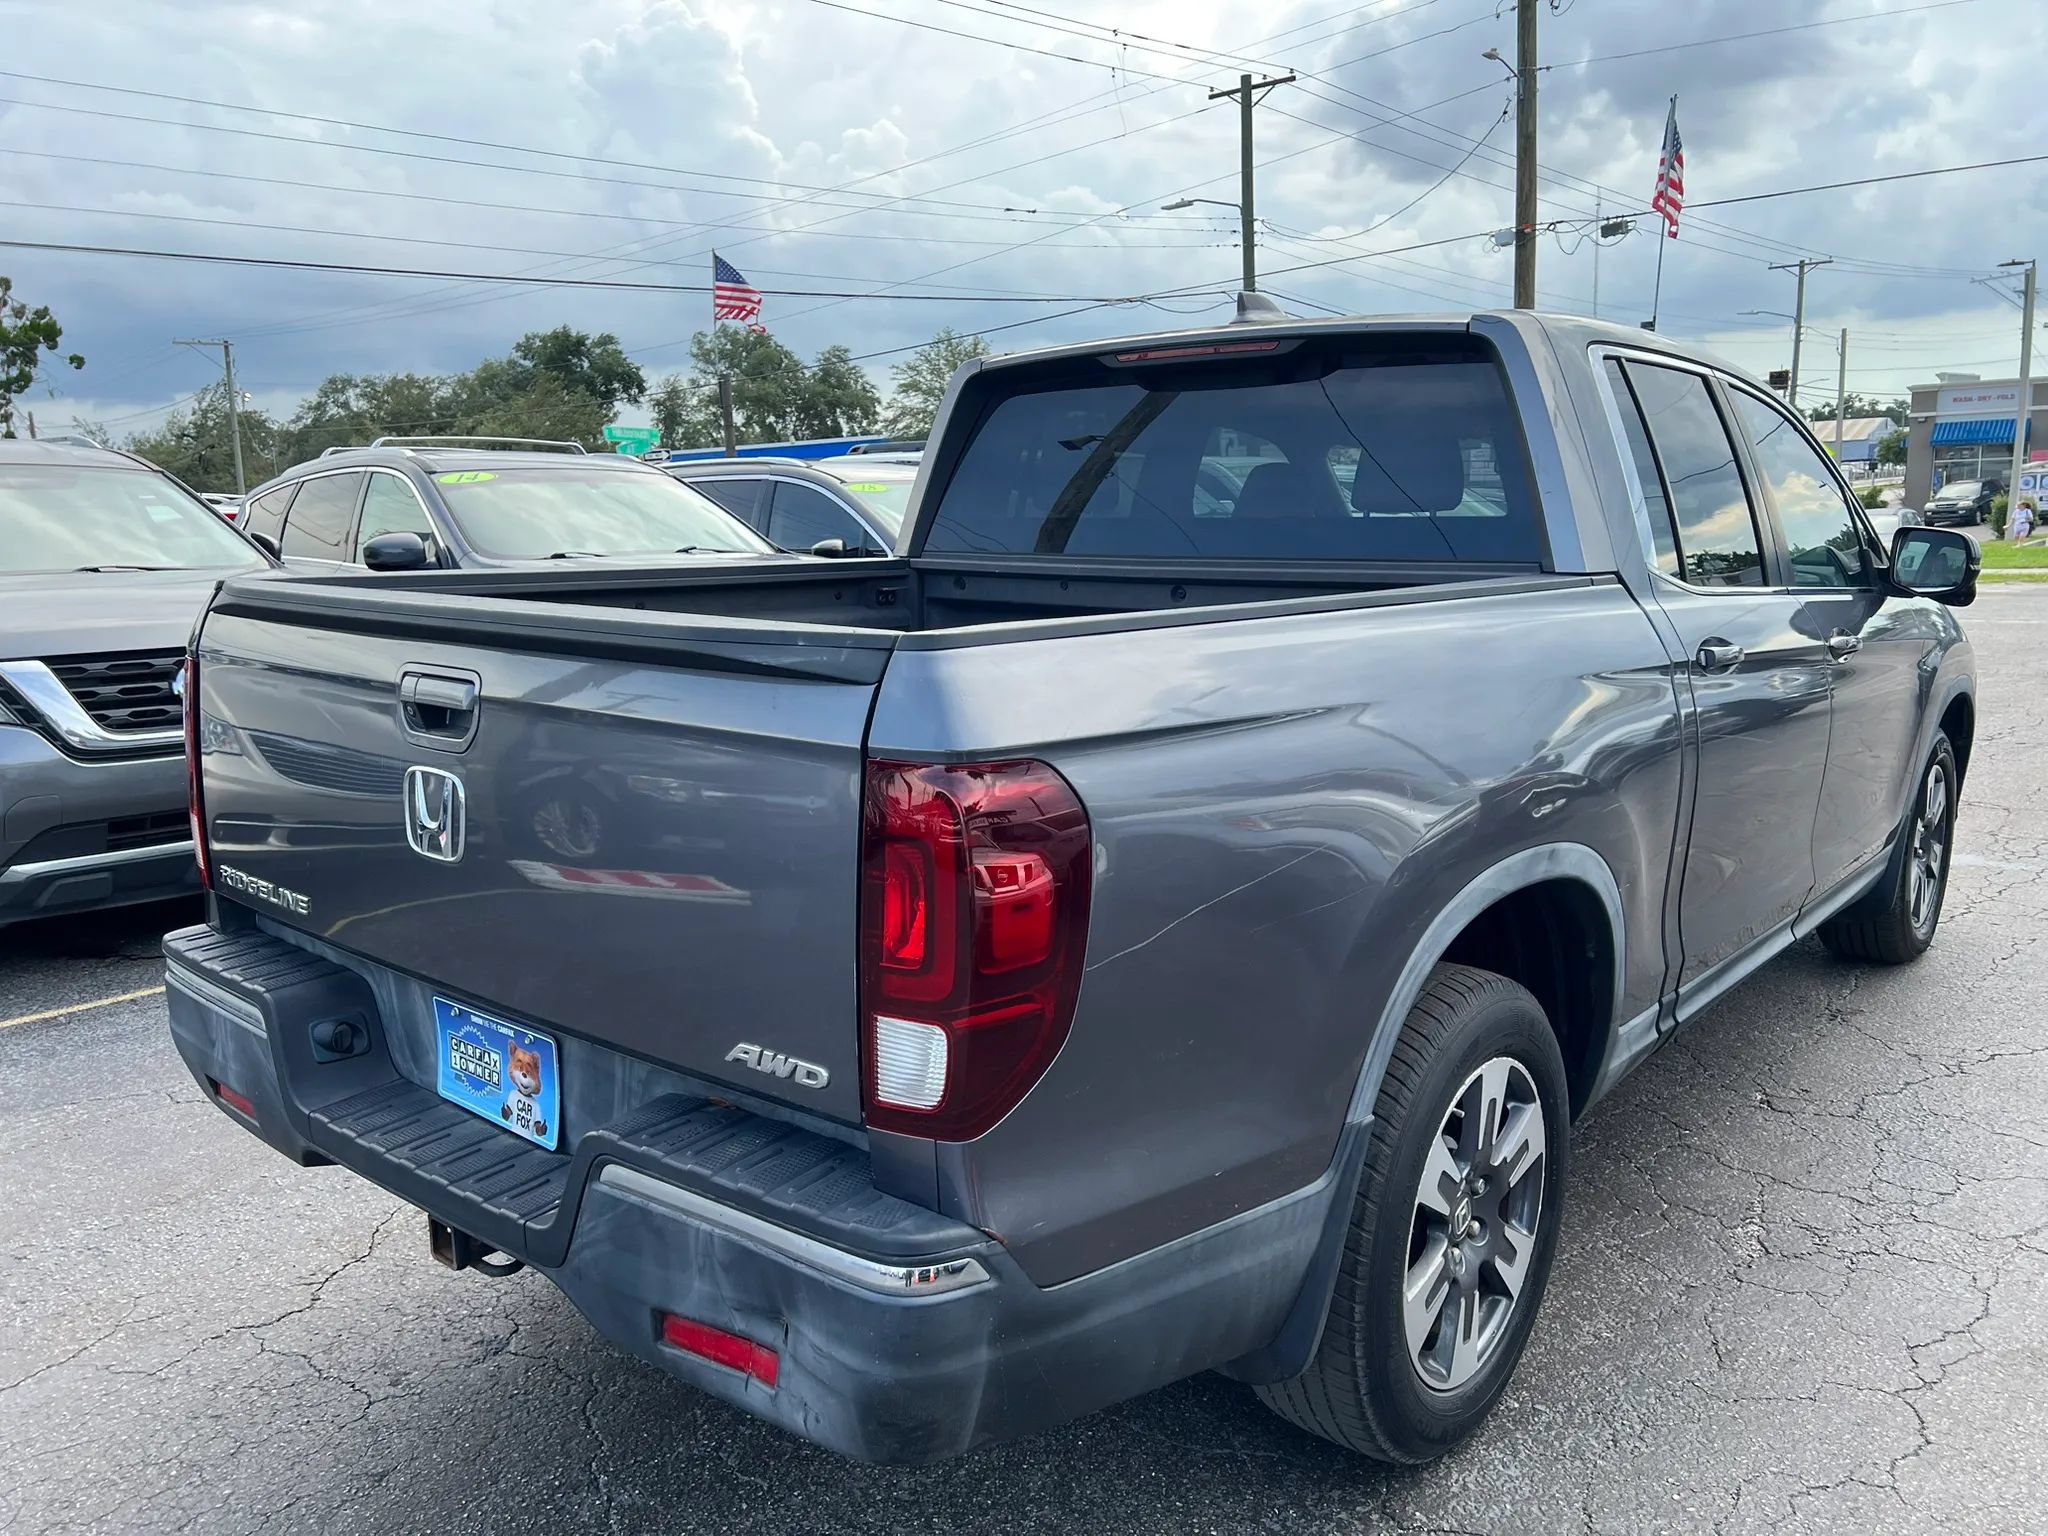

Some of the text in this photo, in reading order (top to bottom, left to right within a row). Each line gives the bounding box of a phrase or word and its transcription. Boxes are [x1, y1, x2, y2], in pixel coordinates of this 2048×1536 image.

[219, 864, 312, 915] RIDGELINE
[451, 1038, 499, 1069] CARFAX
[724, 1042, 832, 1089] AWD
[516, 1099, 533, 1118] CAR
[516, 1113, 532, 1132] FOX
